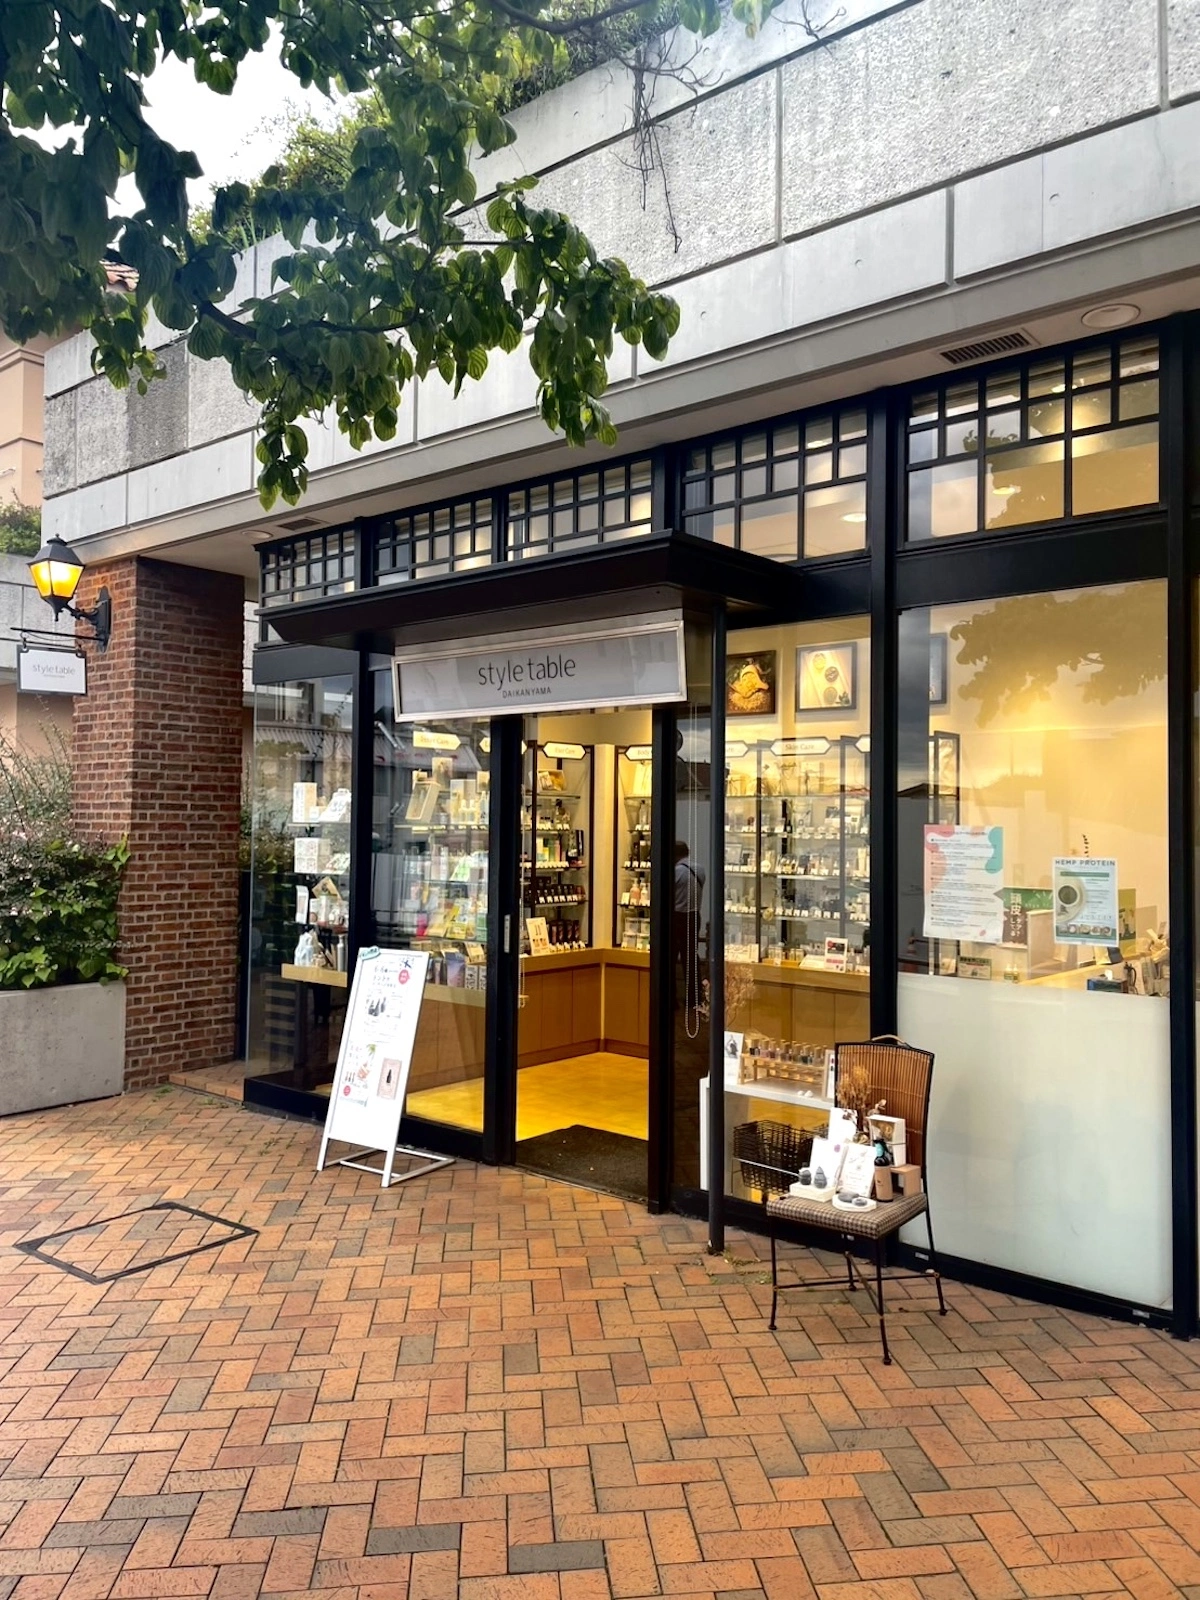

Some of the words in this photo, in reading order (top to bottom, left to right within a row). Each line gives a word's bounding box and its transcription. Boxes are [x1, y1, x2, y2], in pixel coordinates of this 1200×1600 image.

[32, 664, 54, 674] style
[55, 665, 76, 675] table
[479, 659, 524, 691] style
[527, 654, 576, 682] table
[502, 686, 552, 699] DAIKANYAMA
[785, 743, 798, 751] Skin
